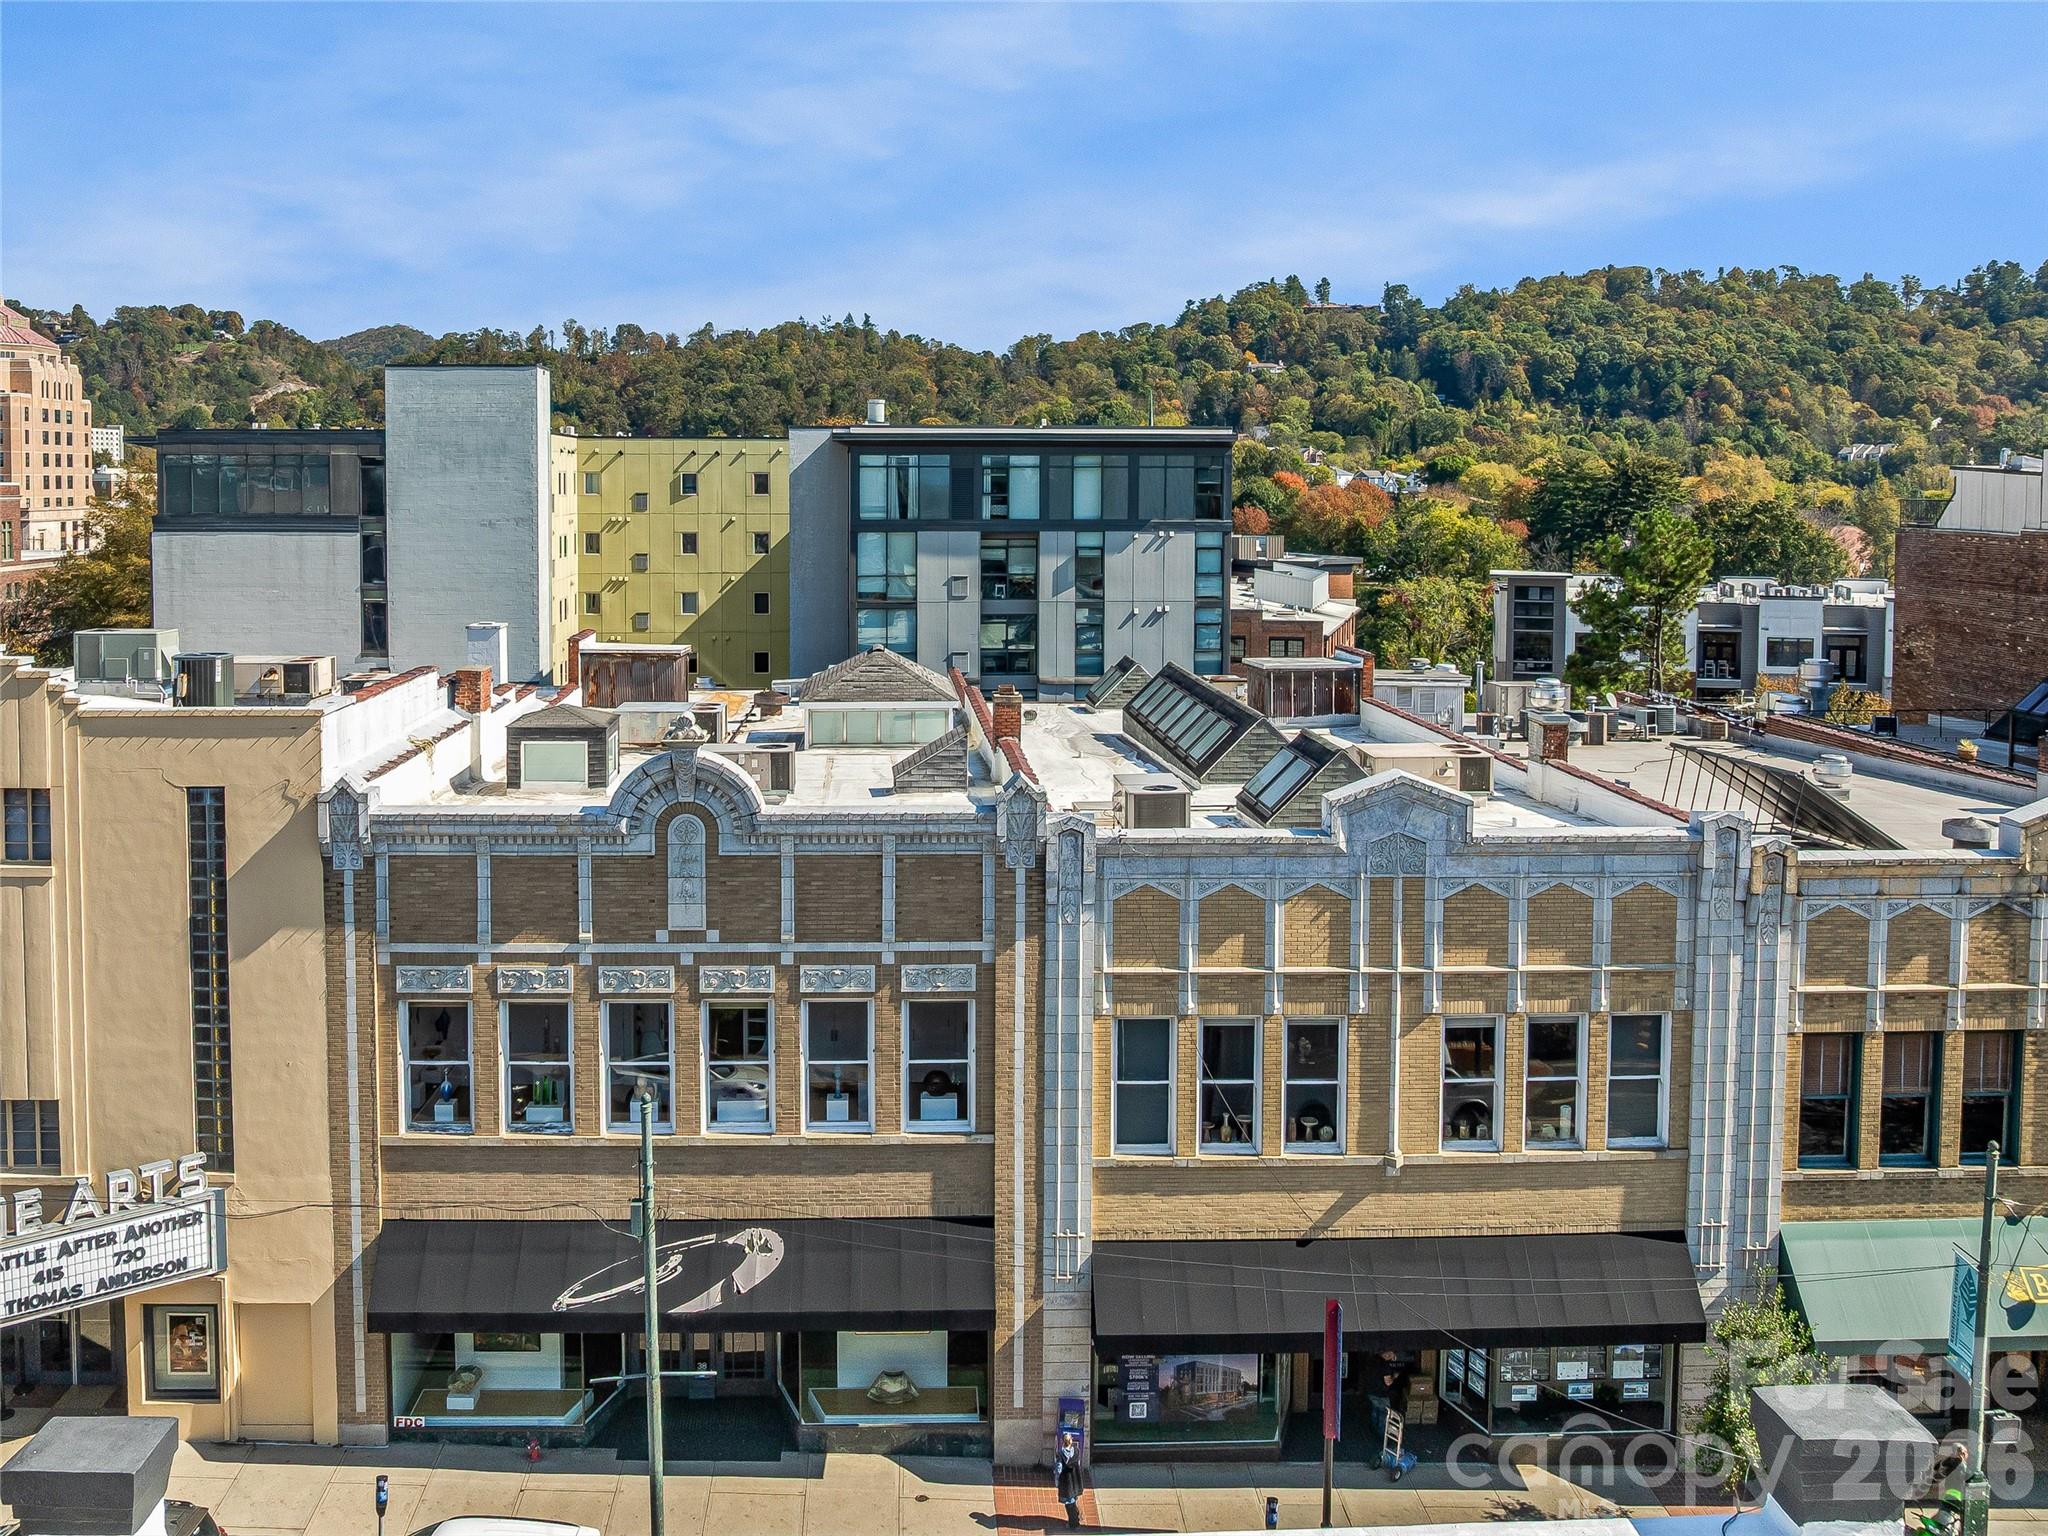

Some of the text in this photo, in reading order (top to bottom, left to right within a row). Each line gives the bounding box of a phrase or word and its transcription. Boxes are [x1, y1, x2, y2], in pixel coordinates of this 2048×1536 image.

[62, 1152, 208, 1225] ARTS
[57, 1230, 118, 1261] AFTER
[123, 1211, 203, 1244] ANOTHER
[5, 1256, 188, 1315] THOMAS ANDERSON
[32, 1246, 146, 1286] 415 730
[697, 1362, 707, 1370] 38
[396, 1417, 423, 1428] FDC
